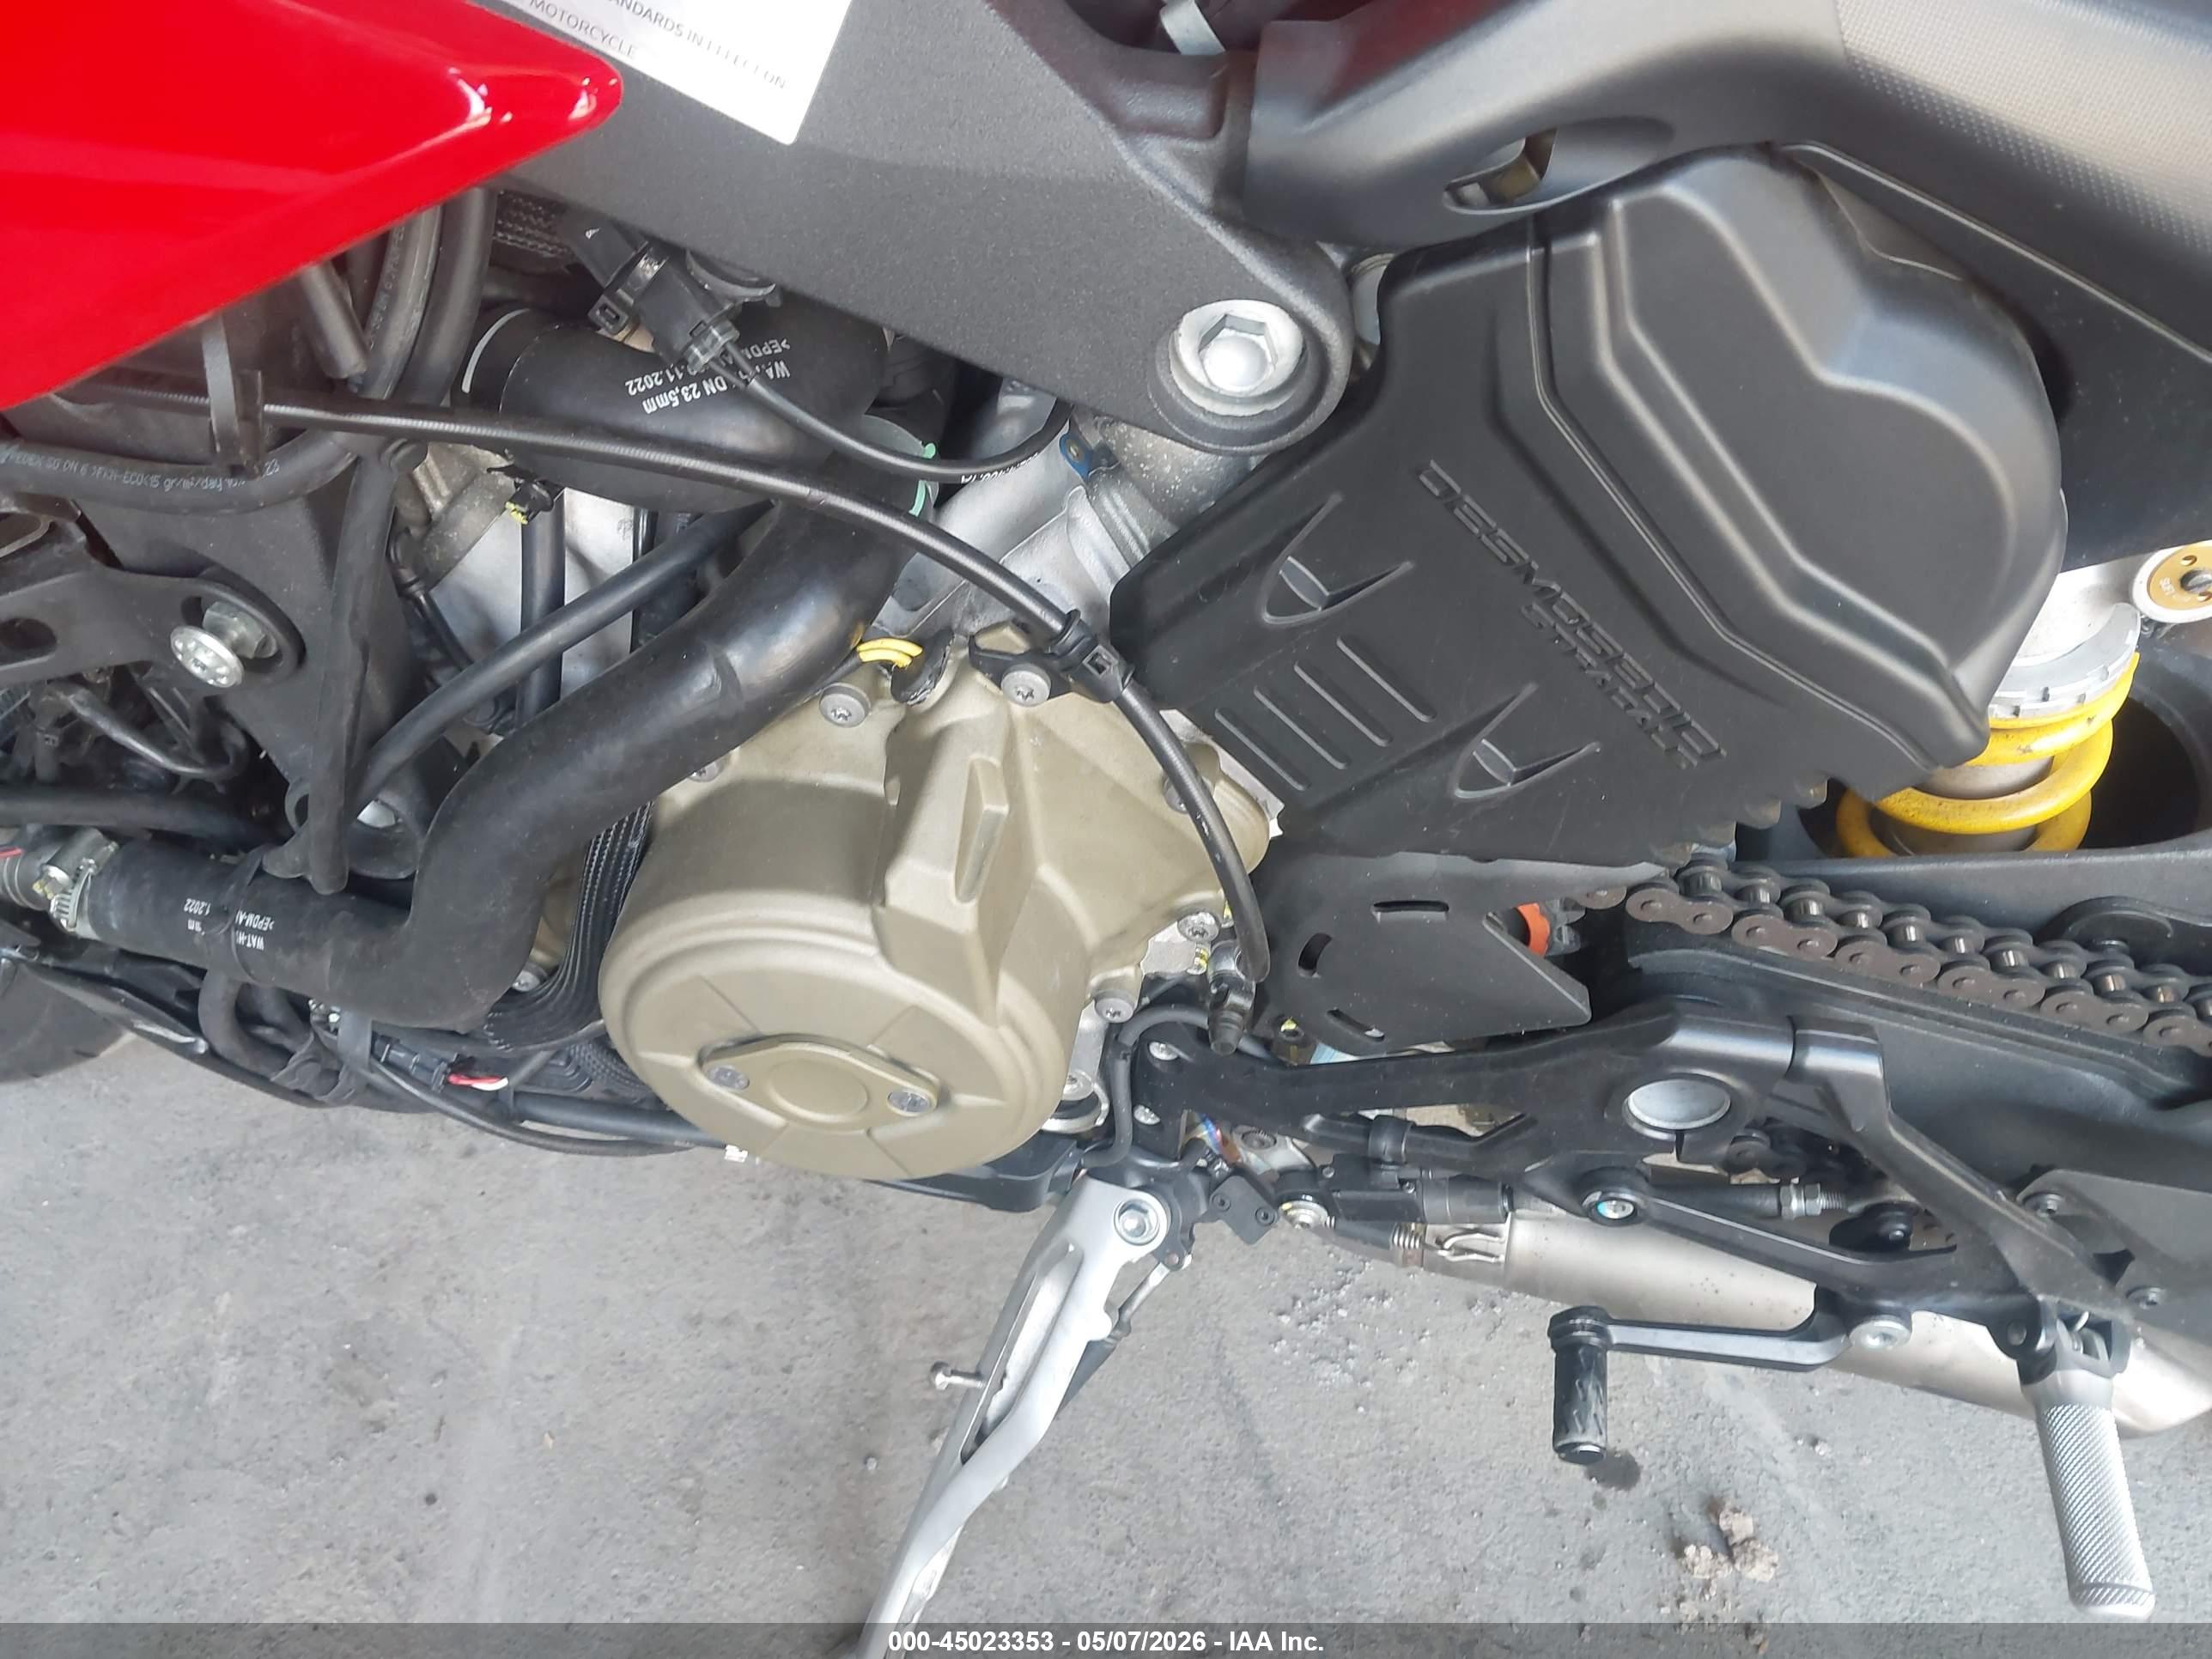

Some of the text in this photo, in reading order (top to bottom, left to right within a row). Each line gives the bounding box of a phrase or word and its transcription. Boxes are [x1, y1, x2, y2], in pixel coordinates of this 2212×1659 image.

[529, 0, 636, 58] MOTORCYCLE
[641, 375, 728, 414] DN 23,5mm
[183, 897, 211, 916] 1.2022
